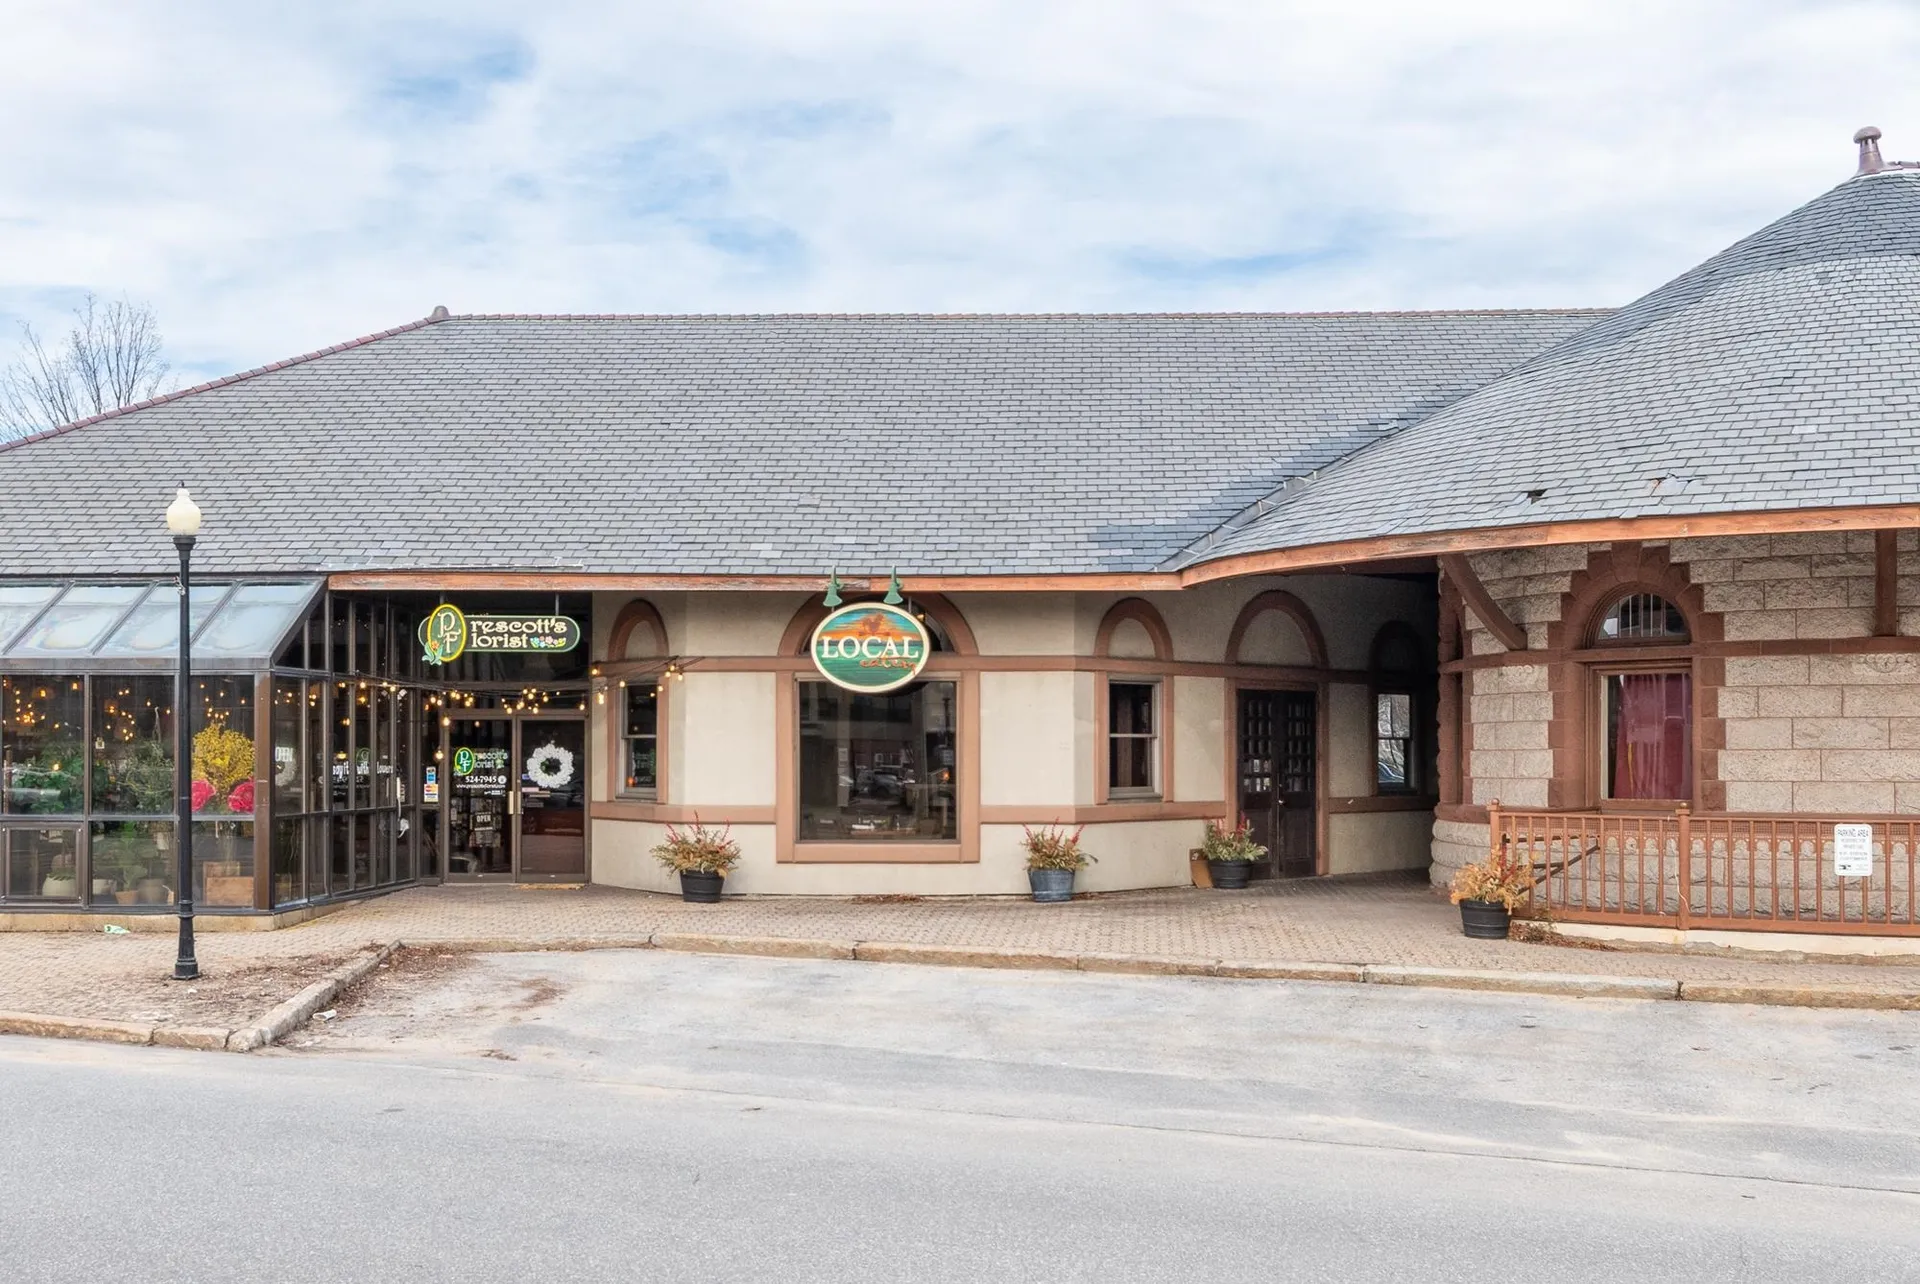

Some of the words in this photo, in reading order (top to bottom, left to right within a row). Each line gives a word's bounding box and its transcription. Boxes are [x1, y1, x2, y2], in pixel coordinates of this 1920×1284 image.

[821, 636, 919, 658] LOCAL
[376, 761, 394, 774] lowers
[476, 815, 492, 823] OPEN
